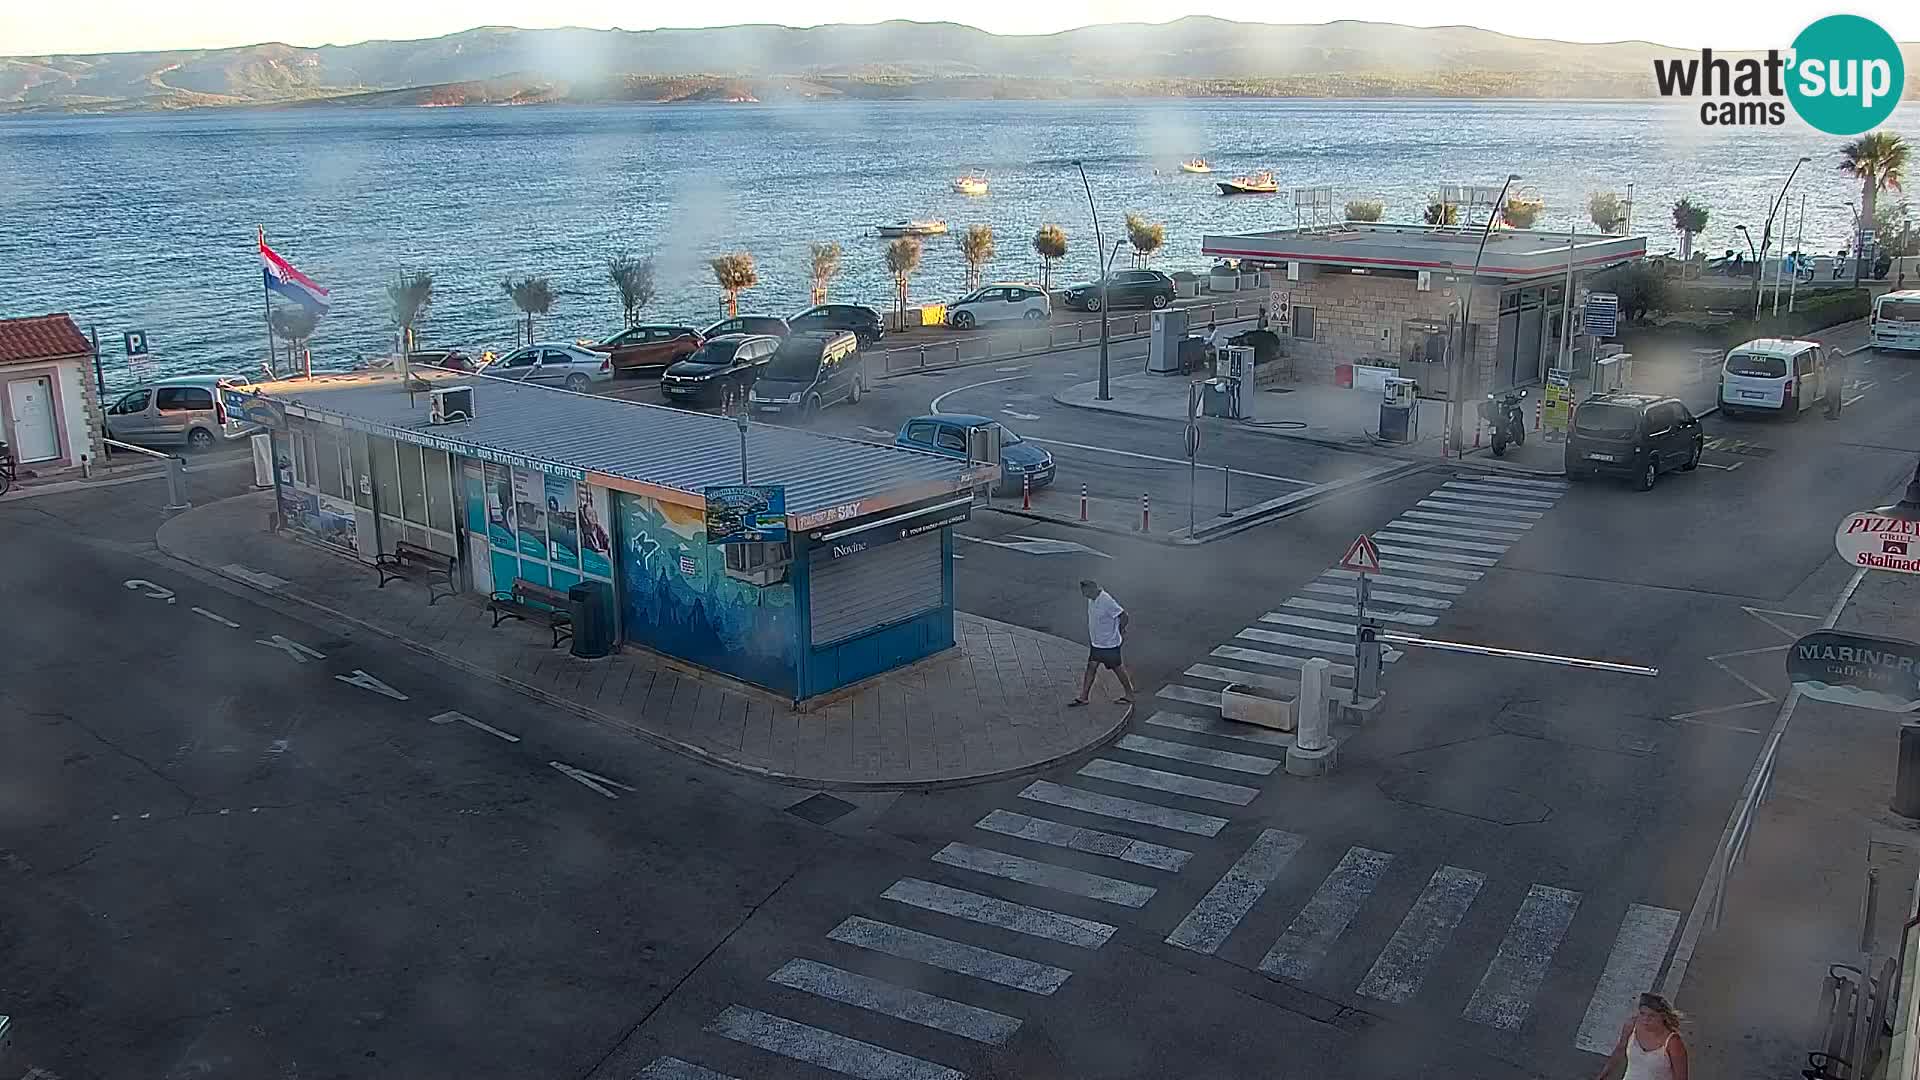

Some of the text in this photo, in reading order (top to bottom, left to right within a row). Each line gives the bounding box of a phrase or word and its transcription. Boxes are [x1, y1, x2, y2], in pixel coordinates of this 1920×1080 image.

[129, 334, 142, 352] P
[396, 432, 434, 447] AUTOBUSNA
[436, 439, 467, 455] POSTAJA
[477, 449, 492, 460] BUS
[493, 453, 525, 467] STATION
[527, 459, 554, 473] TICKET
[555, 465, 582, 480] OFFICE
[1880, 532, 1916, 543] GRILL
[1857, 552, 1920, 572] Skalinad
